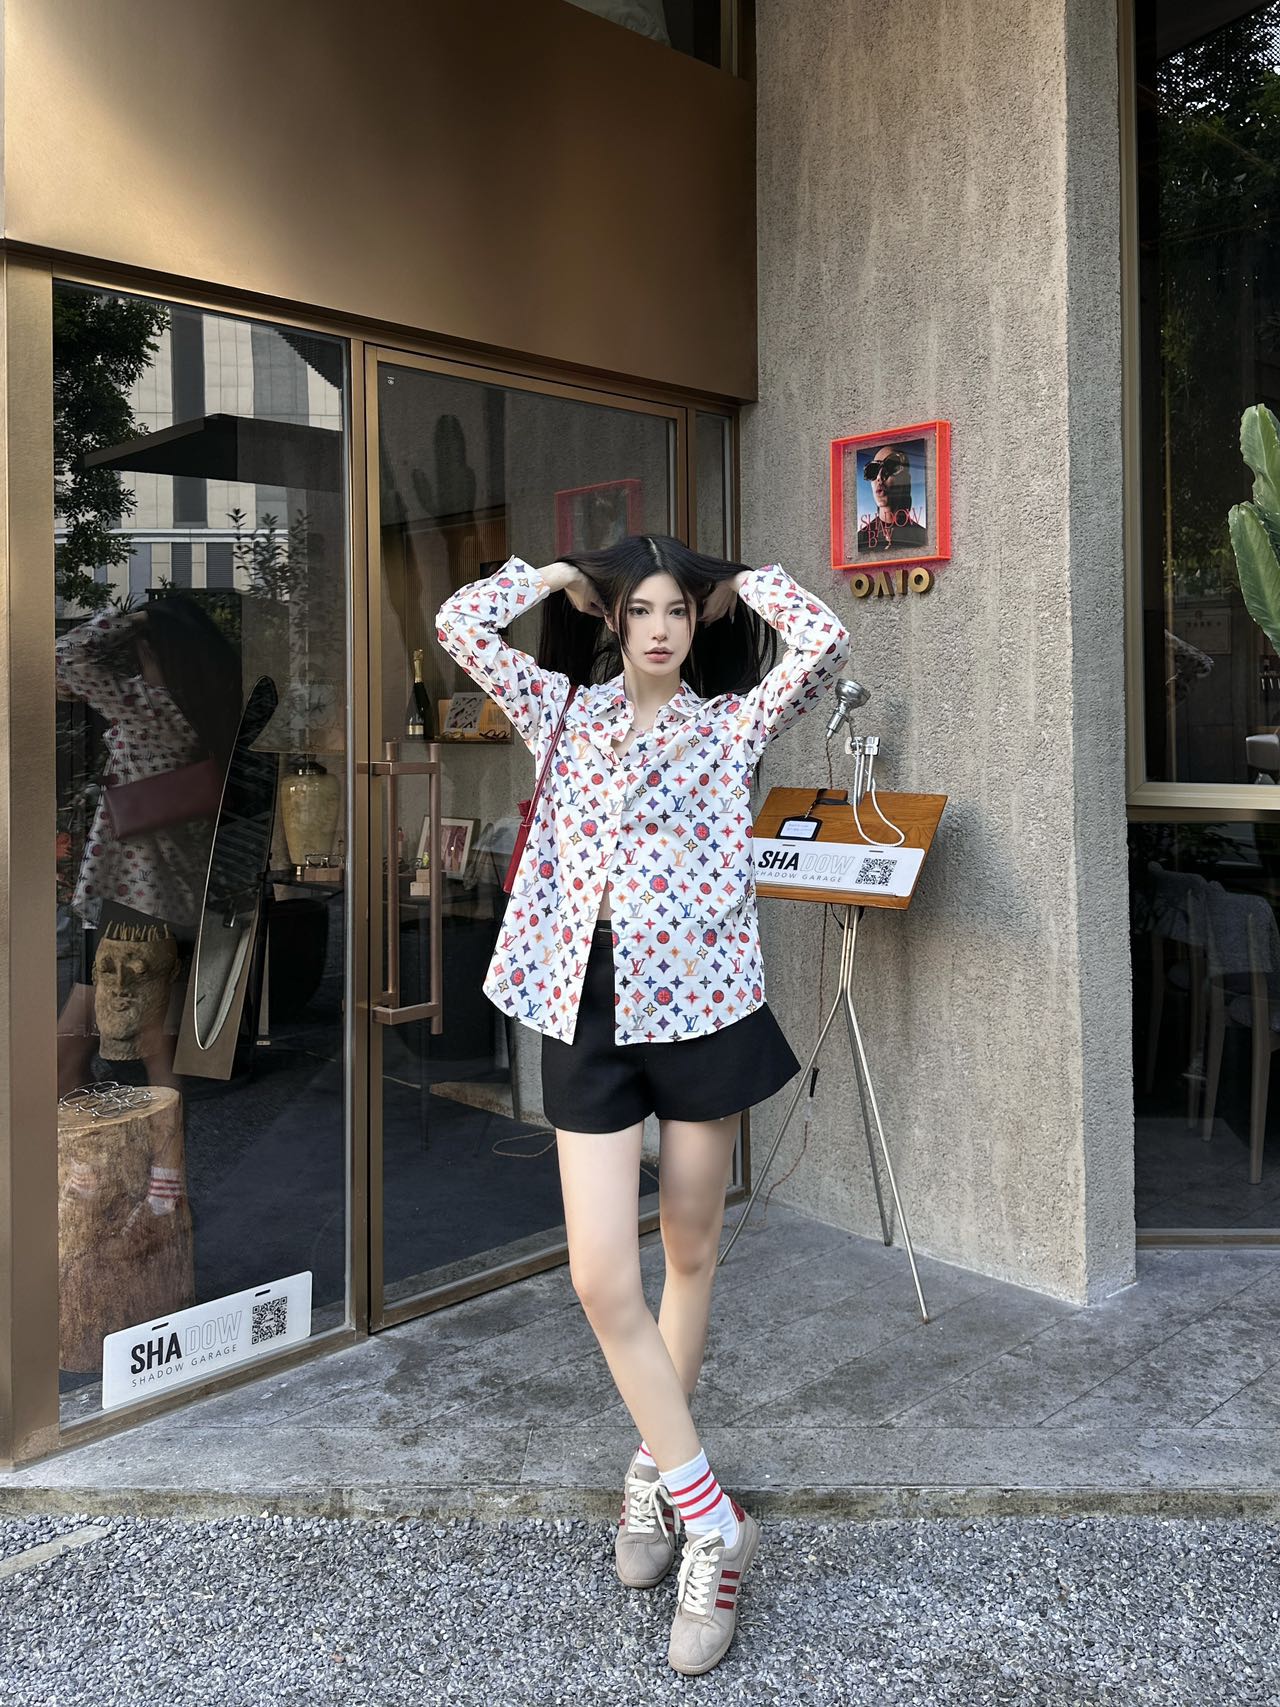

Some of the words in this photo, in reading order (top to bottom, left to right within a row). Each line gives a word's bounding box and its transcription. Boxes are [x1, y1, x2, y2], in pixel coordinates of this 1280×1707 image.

[860, 506, 923, 534] SHADOW
[758, 850, 855, 875] SHADOW
[755, 871, 797, 879] SHADOW
[802, 873, 843, 883] GARAGE
[131, 1311, 243, 1375] SHADOW
[132, 1363, 185, 1387] SHADOW
[191, 1345, 237, 1366] GARAGE
